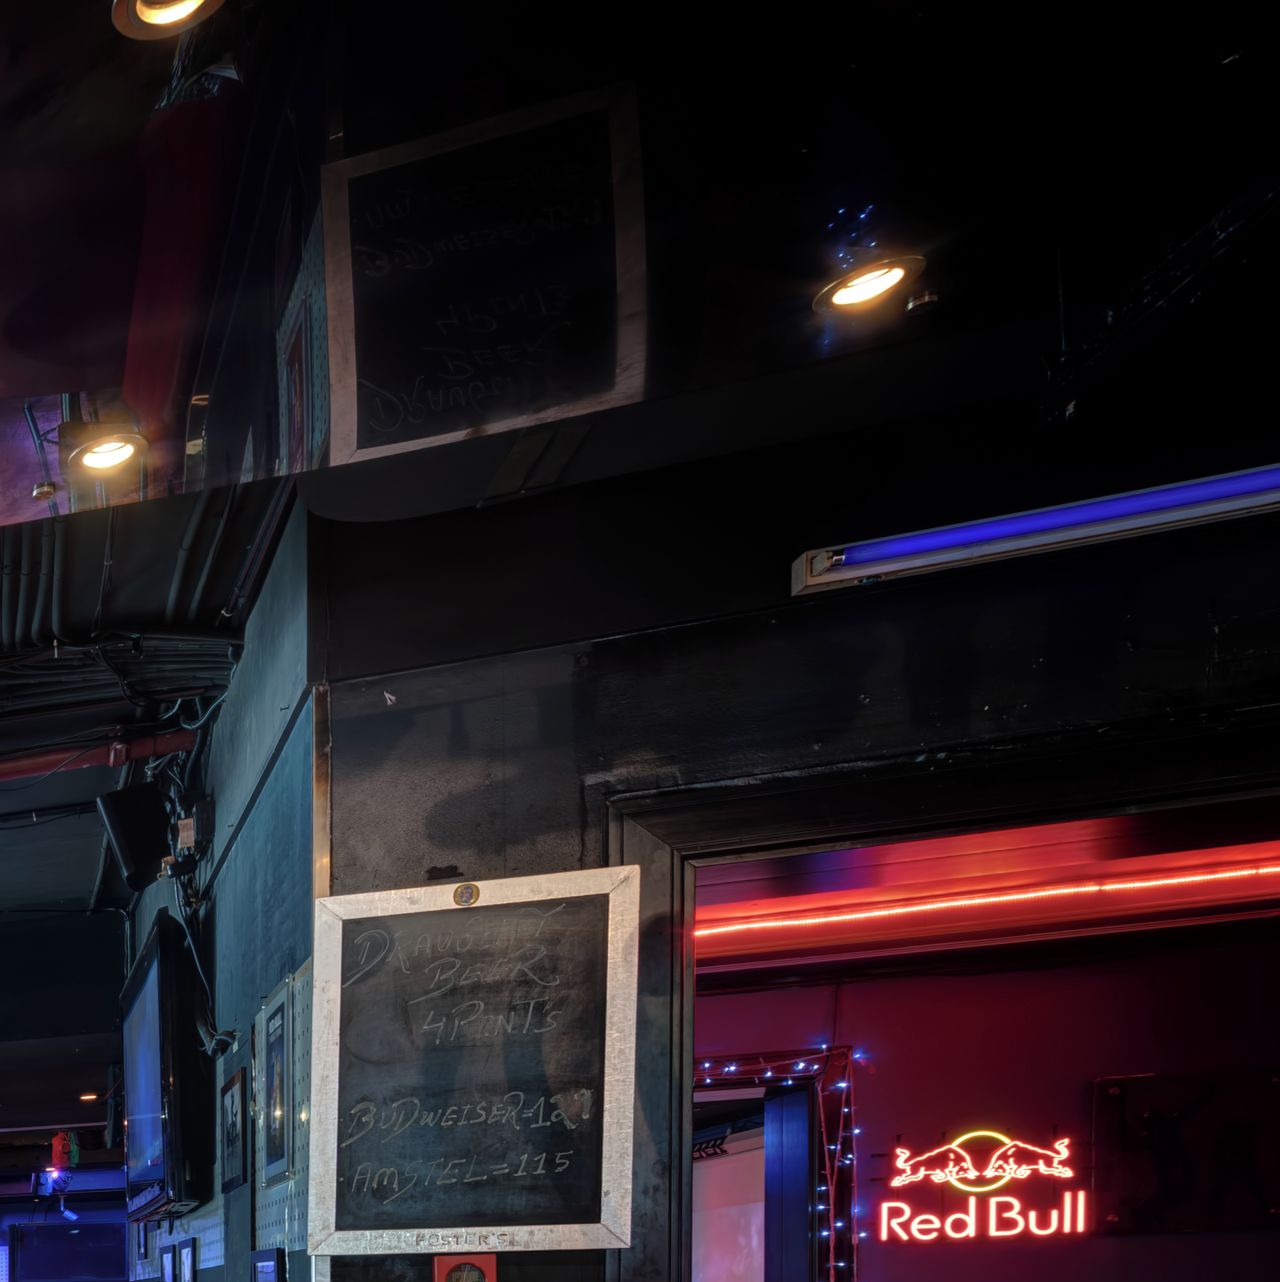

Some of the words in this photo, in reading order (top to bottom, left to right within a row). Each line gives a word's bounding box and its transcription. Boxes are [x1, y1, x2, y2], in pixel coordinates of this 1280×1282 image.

[880, 1197, 976, 1242] Red
[988, 1191, 1086, 1237] Bull
[415, 1232, 510, 1247] FOSTER'S
